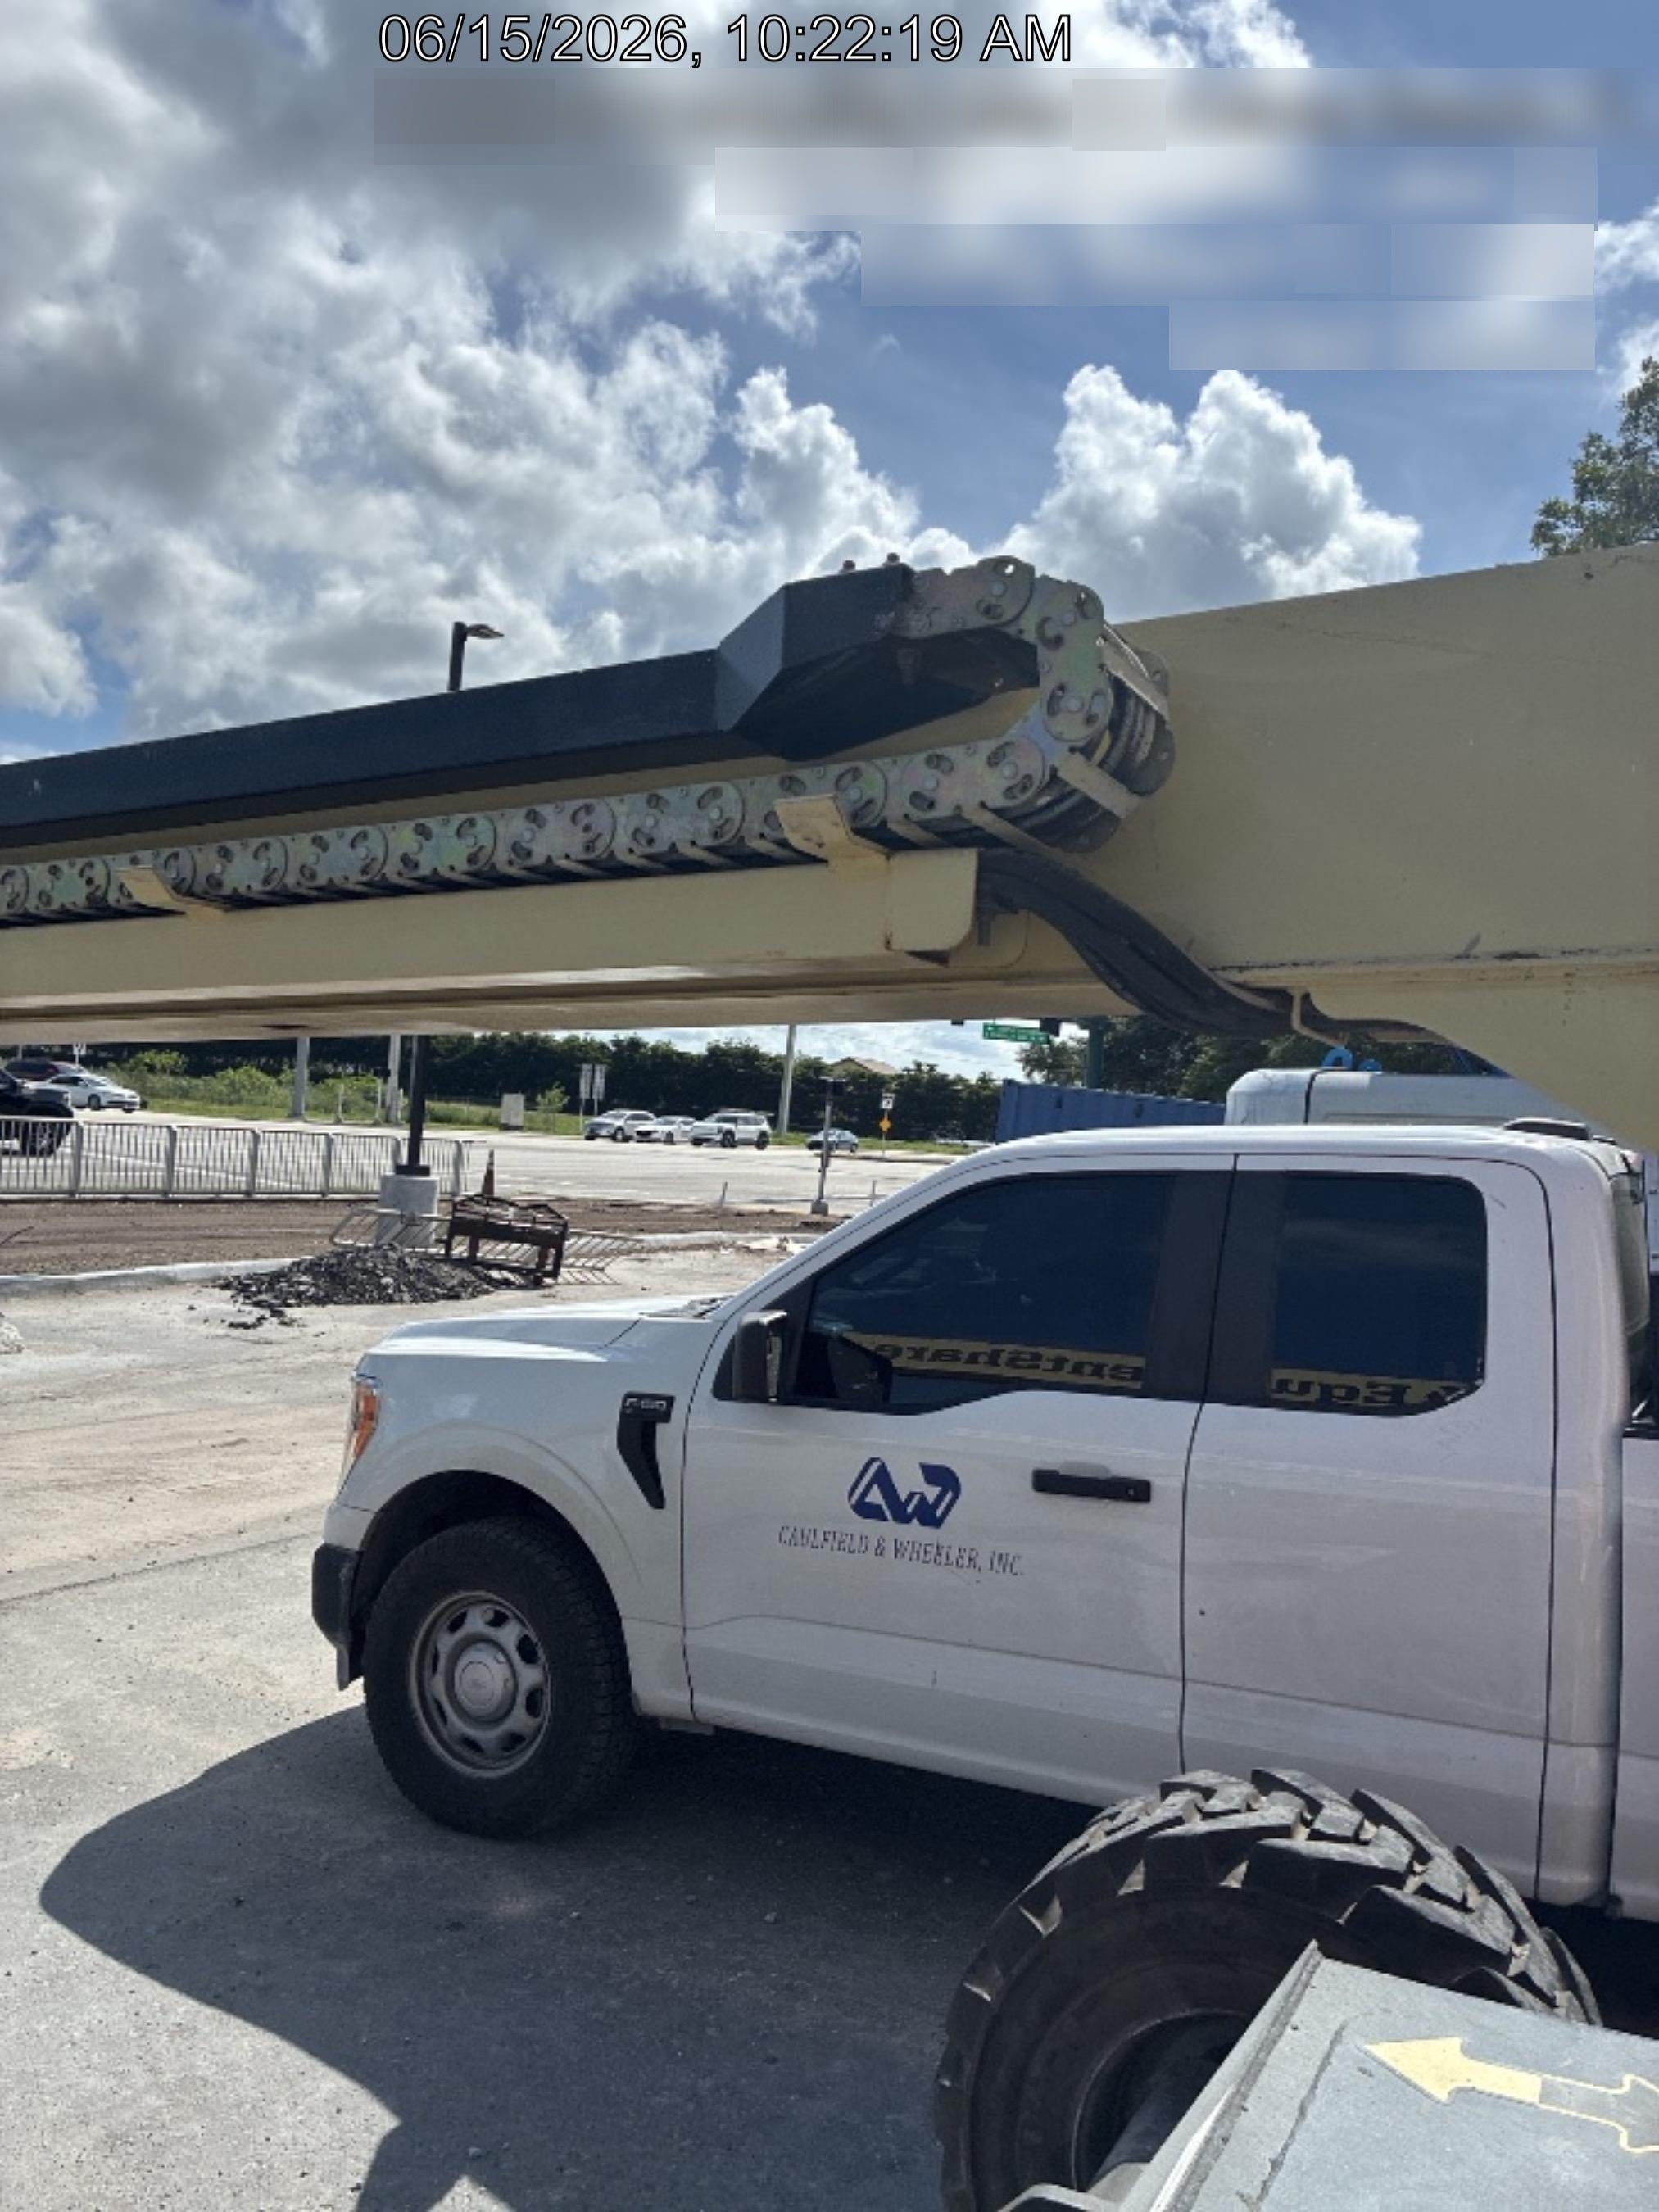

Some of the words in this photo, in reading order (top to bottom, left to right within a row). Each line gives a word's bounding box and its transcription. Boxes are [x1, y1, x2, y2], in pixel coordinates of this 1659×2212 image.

[778, 1525, 868, 1555] CAULFIELD
[874, 1535, 886, 1557] &
[894, 1538, 982, 1573] WHEELER,
[989, 1550, 1024, 1575] INC.
